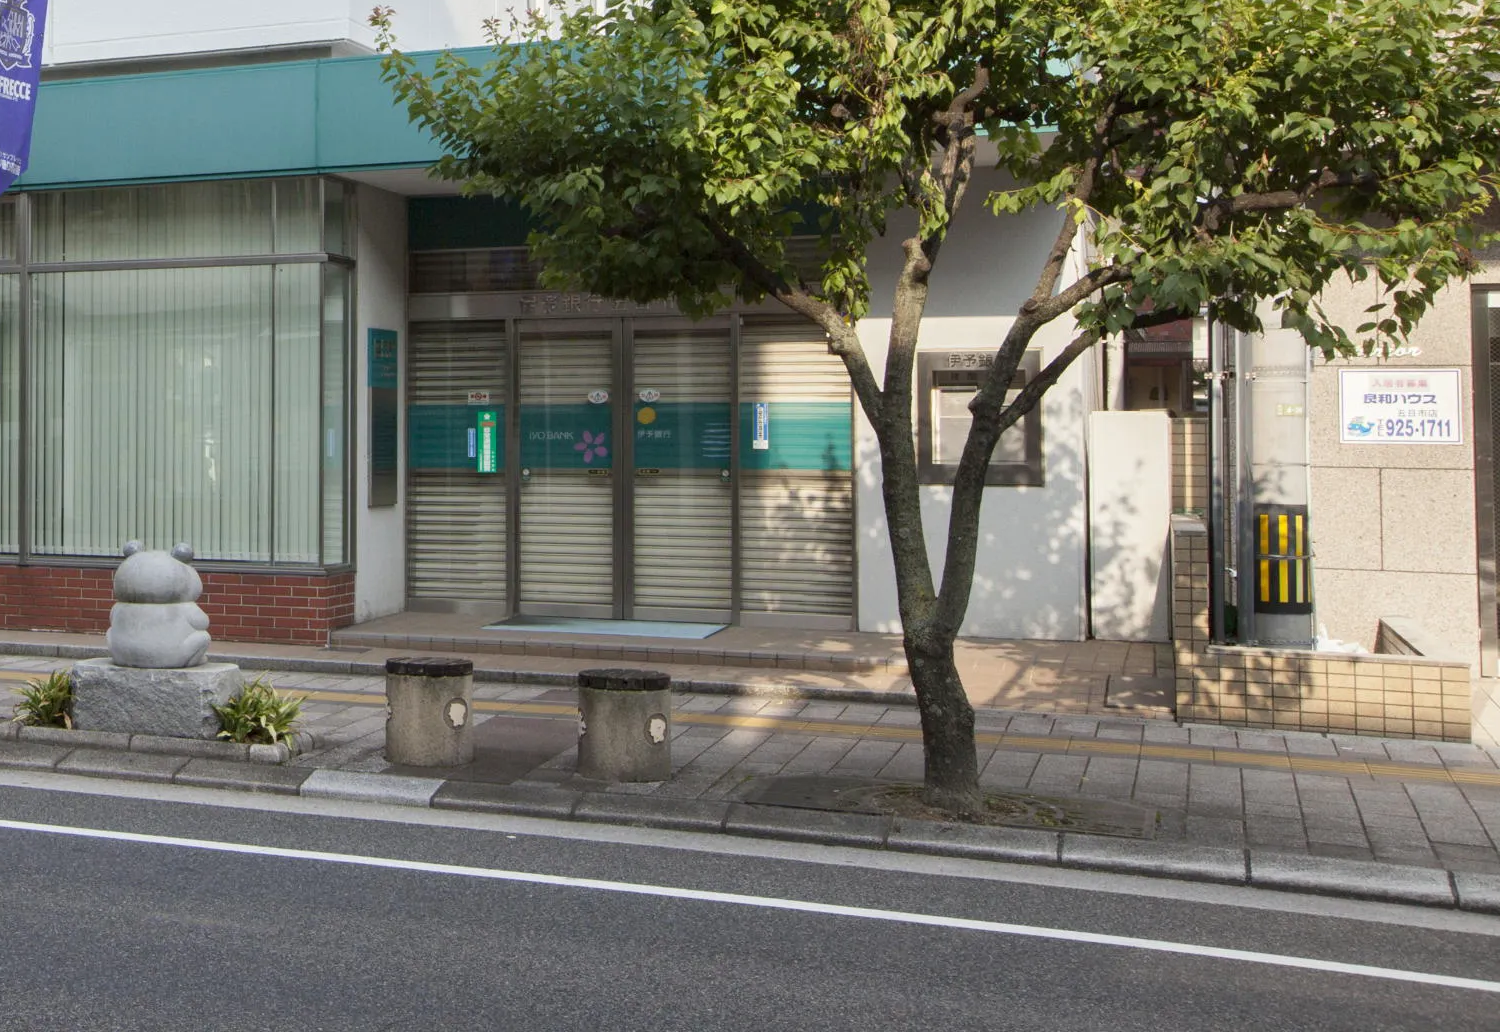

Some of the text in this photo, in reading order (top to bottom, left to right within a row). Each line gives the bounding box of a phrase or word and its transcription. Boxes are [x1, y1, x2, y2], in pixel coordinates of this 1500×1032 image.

[948, 354, 994, 368] 伊予銀
[1363, 393, 1437, 404] 良和ハウス
